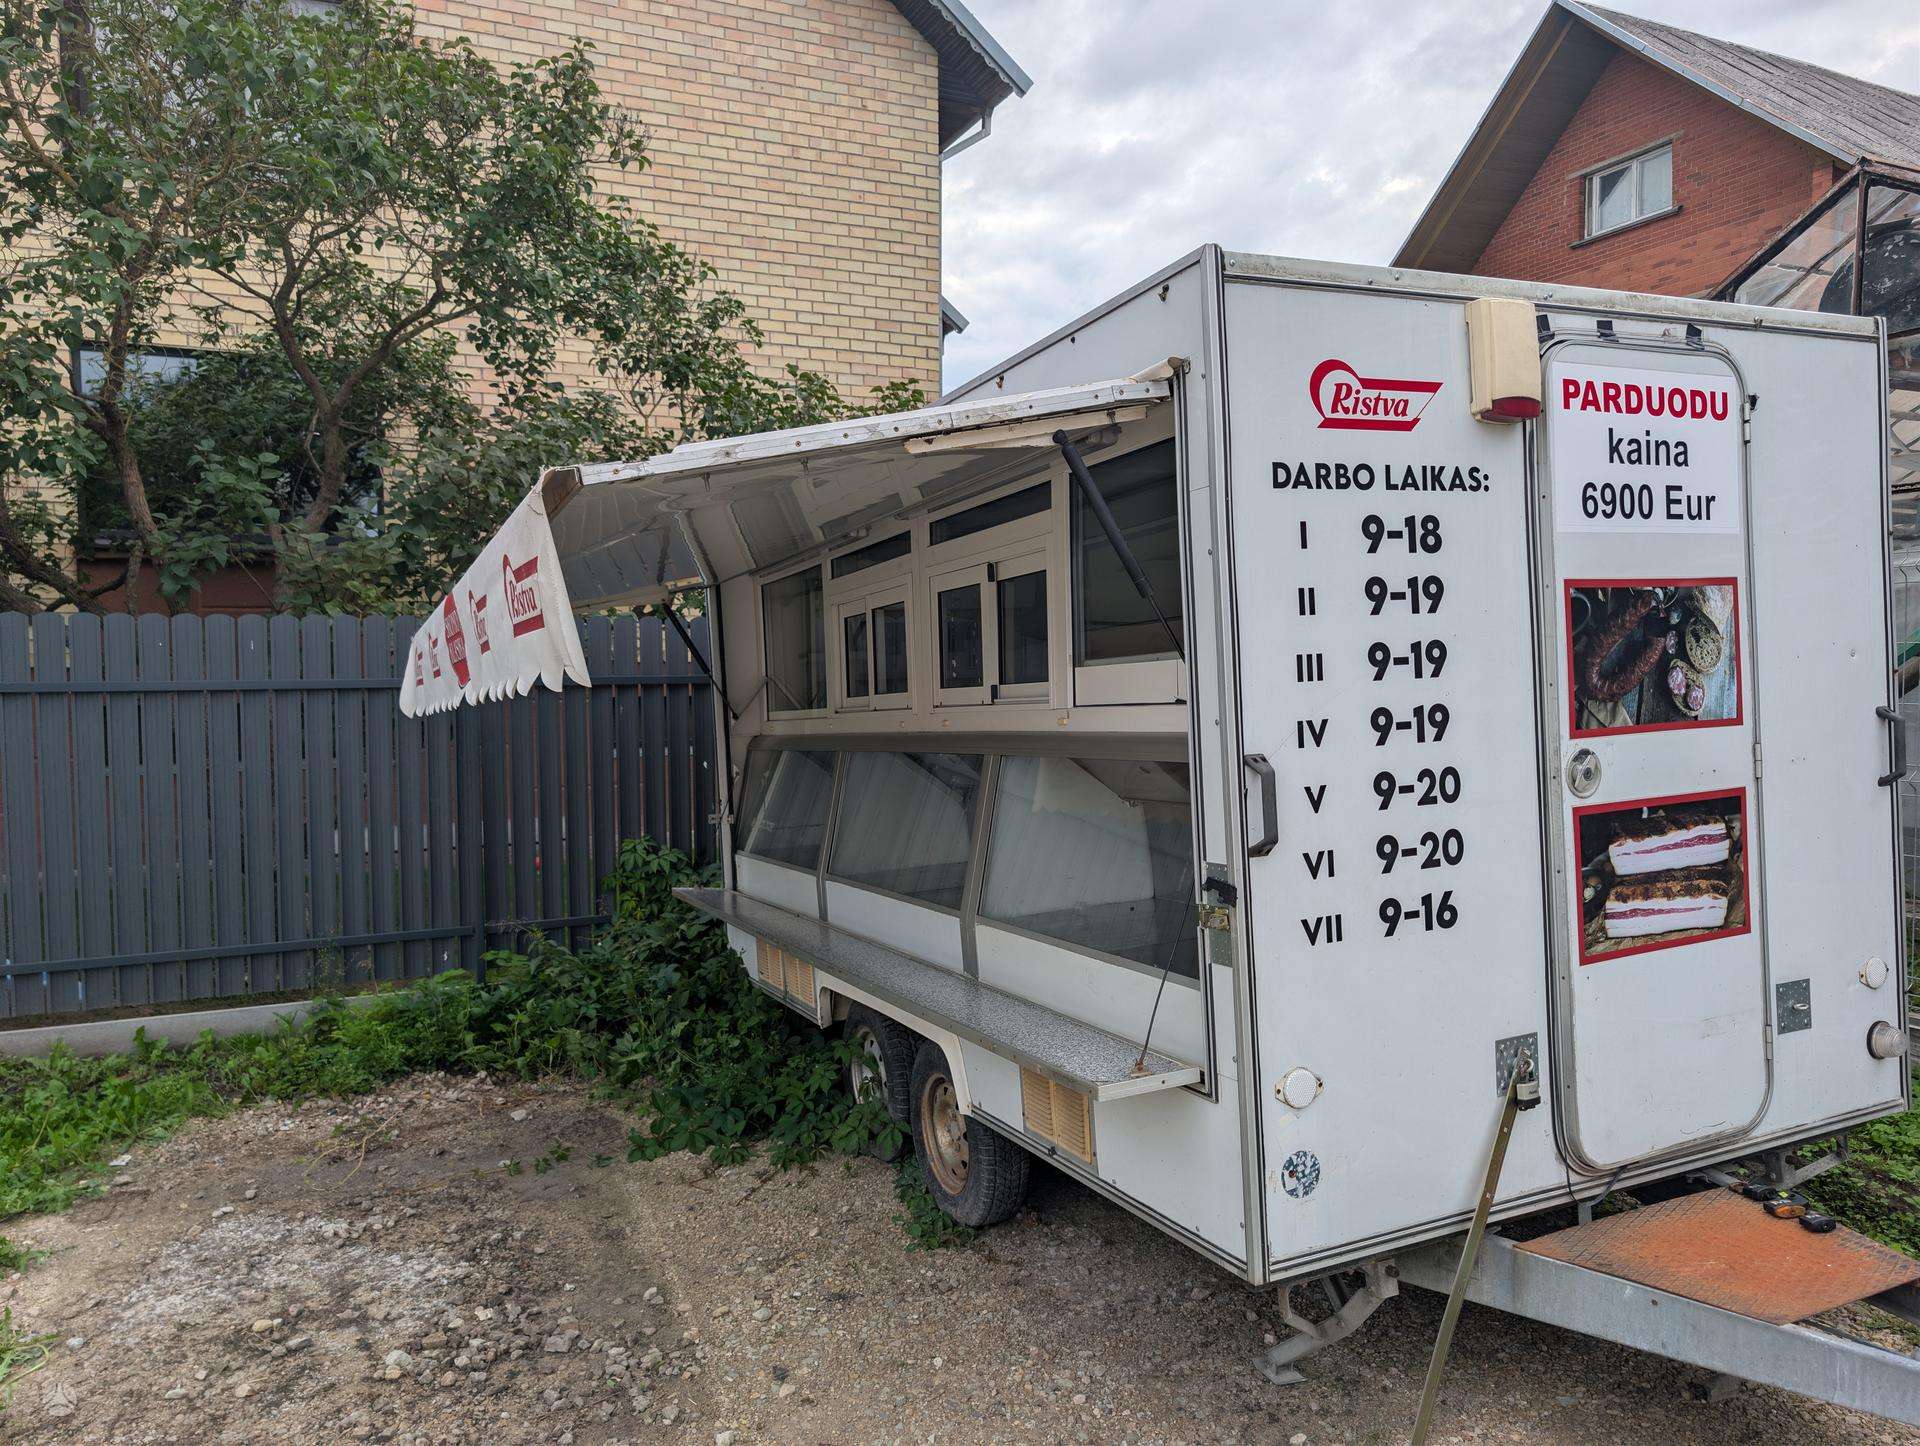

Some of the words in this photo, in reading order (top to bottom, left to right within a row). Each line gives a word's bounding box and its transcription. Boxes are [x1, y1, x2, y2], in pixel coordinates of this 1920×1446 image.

[1330, 382, 1409, 417] Ristva
[1562, 379, 1728, 421] PARDUODU
[1609, 428, 1688, 467] kaina
[1272, 462, 1375, 490] DARBO
[1385, 465, 1489, 492] LAIKAS:
[1582, 482, 1653, 519] 6900
[1666, 485, 1715, 520] Eur
[1300, 521, 1307, 549] I
[1362, 515, 1442, 553] 9-18
[510, 581, 538, 618] Ristva
[1298, 588, 1315, 615] II
[1365, 575, 1444, 615] 9-19
[1297, 653, 1323, 682] III
[1368, 640, 1447, 681] 9-19
[1297, 719, 1328, 748] IV
[1371, 704, 1449, 746] 9-19
[1304, 785, 1326, 813] V
[1373, 766, 1461, 810] 9-20
[1303, 850, 1334, 879] VI
[1376, 829, 1464, 874] 9-20
[1301, 914, 1342, 946] VII
[1379, 891, 1458, 937] 9-16
